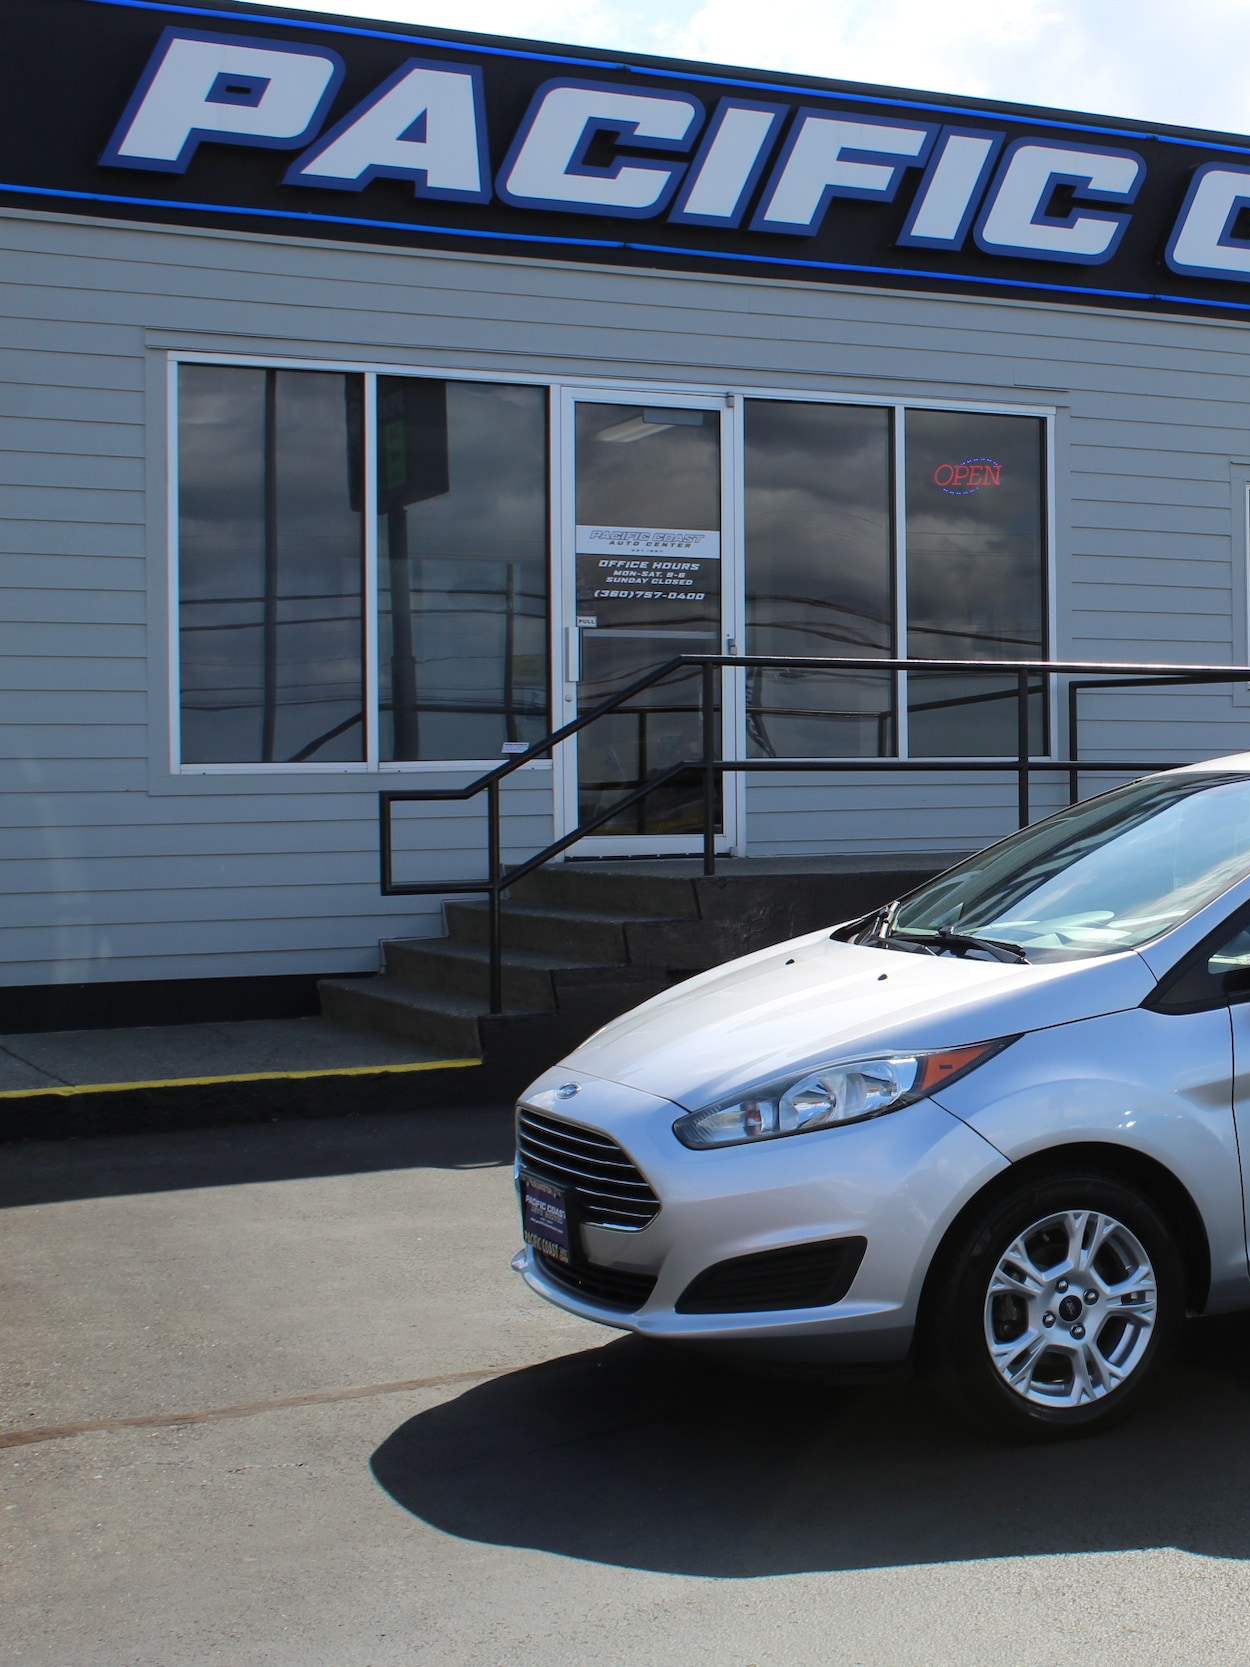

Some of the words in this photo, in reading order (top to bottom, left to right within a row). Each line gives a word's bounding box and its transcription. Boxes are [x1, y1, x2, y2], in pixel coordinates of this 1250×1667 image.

[108, 32, 1143, 260] PACIFIC
[934, 464, 1003, 486] OPEN
[590, 530, 650, 541] PACIFIC
[652, 533, 705, 544] COAST
[598, 560, 650, 569] OFFICE
[652, 562, 700, 571] HOURS
[613, 570, 663, 578] MON-SAT.
[605, 576, 649, 584] SUNDAY
[651, 578, 693, 586] CLOSED
[594, 590, 705, 600] (360)757-0400
[547, 1204, 566, 1219] COAST
